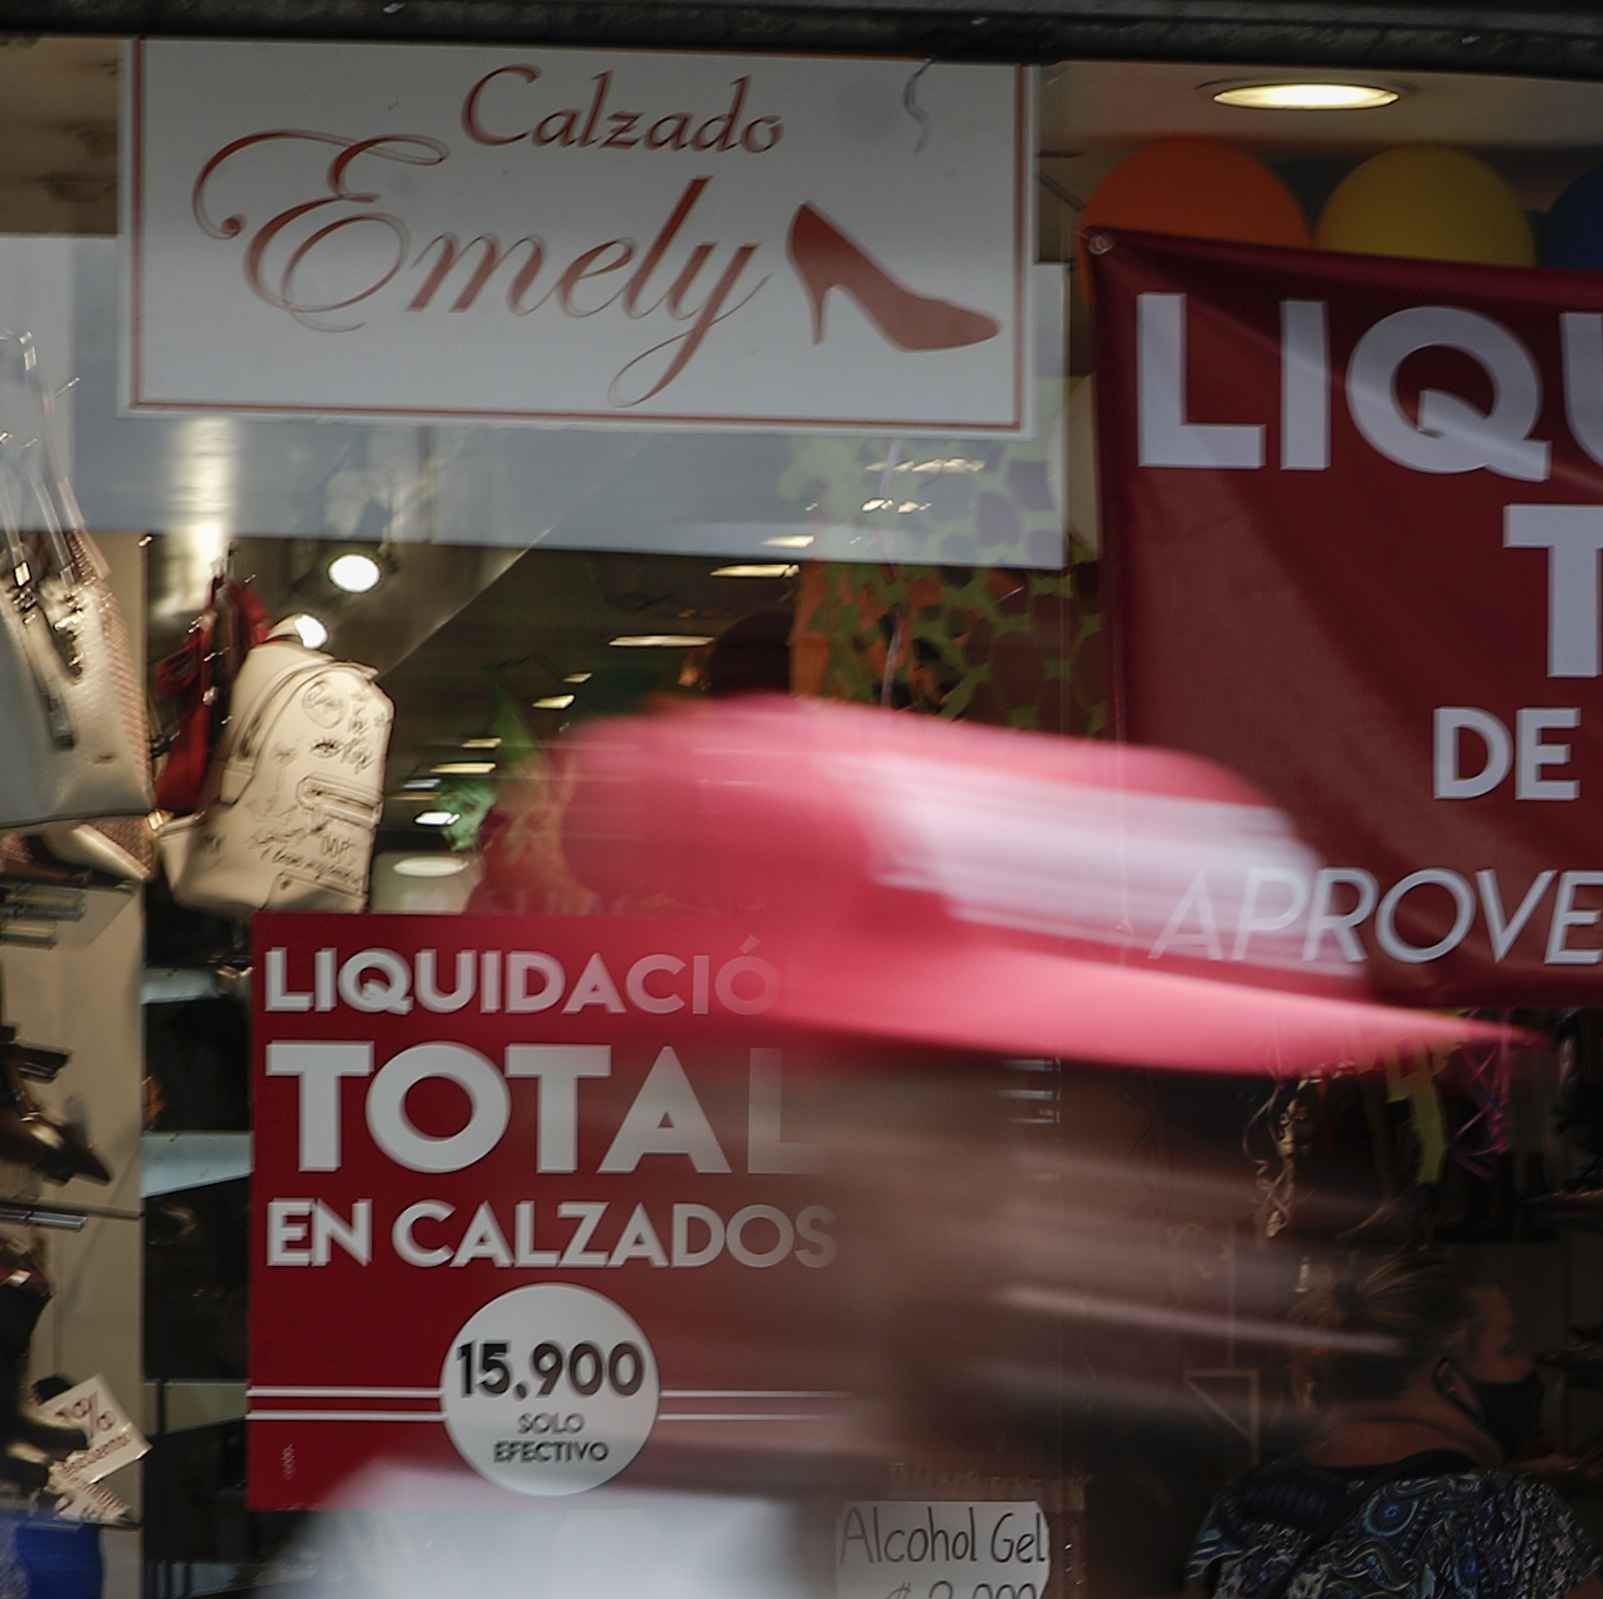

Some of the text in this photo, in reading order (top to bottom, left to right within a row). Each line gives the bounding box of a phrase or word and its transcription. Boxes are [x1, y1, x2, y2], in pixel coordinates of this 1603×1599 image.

[460, 63, 784, 155] Calzado
[191, 129, 771, 408] Emely
[1433, 707, 1581, 801] DE
[264, 935, 785, 1014] LIQUIDACIÓ
[264, 1040, 822, 1174] TOTAL
[265, 1199, 838, 1269] EN CALZADOS
[493, 1440, 609, 1465] EFECTIVO
[516, 1410, 585, 1436] SOLO
[839, 1506, 1047, 1564] Alcohol Gel
